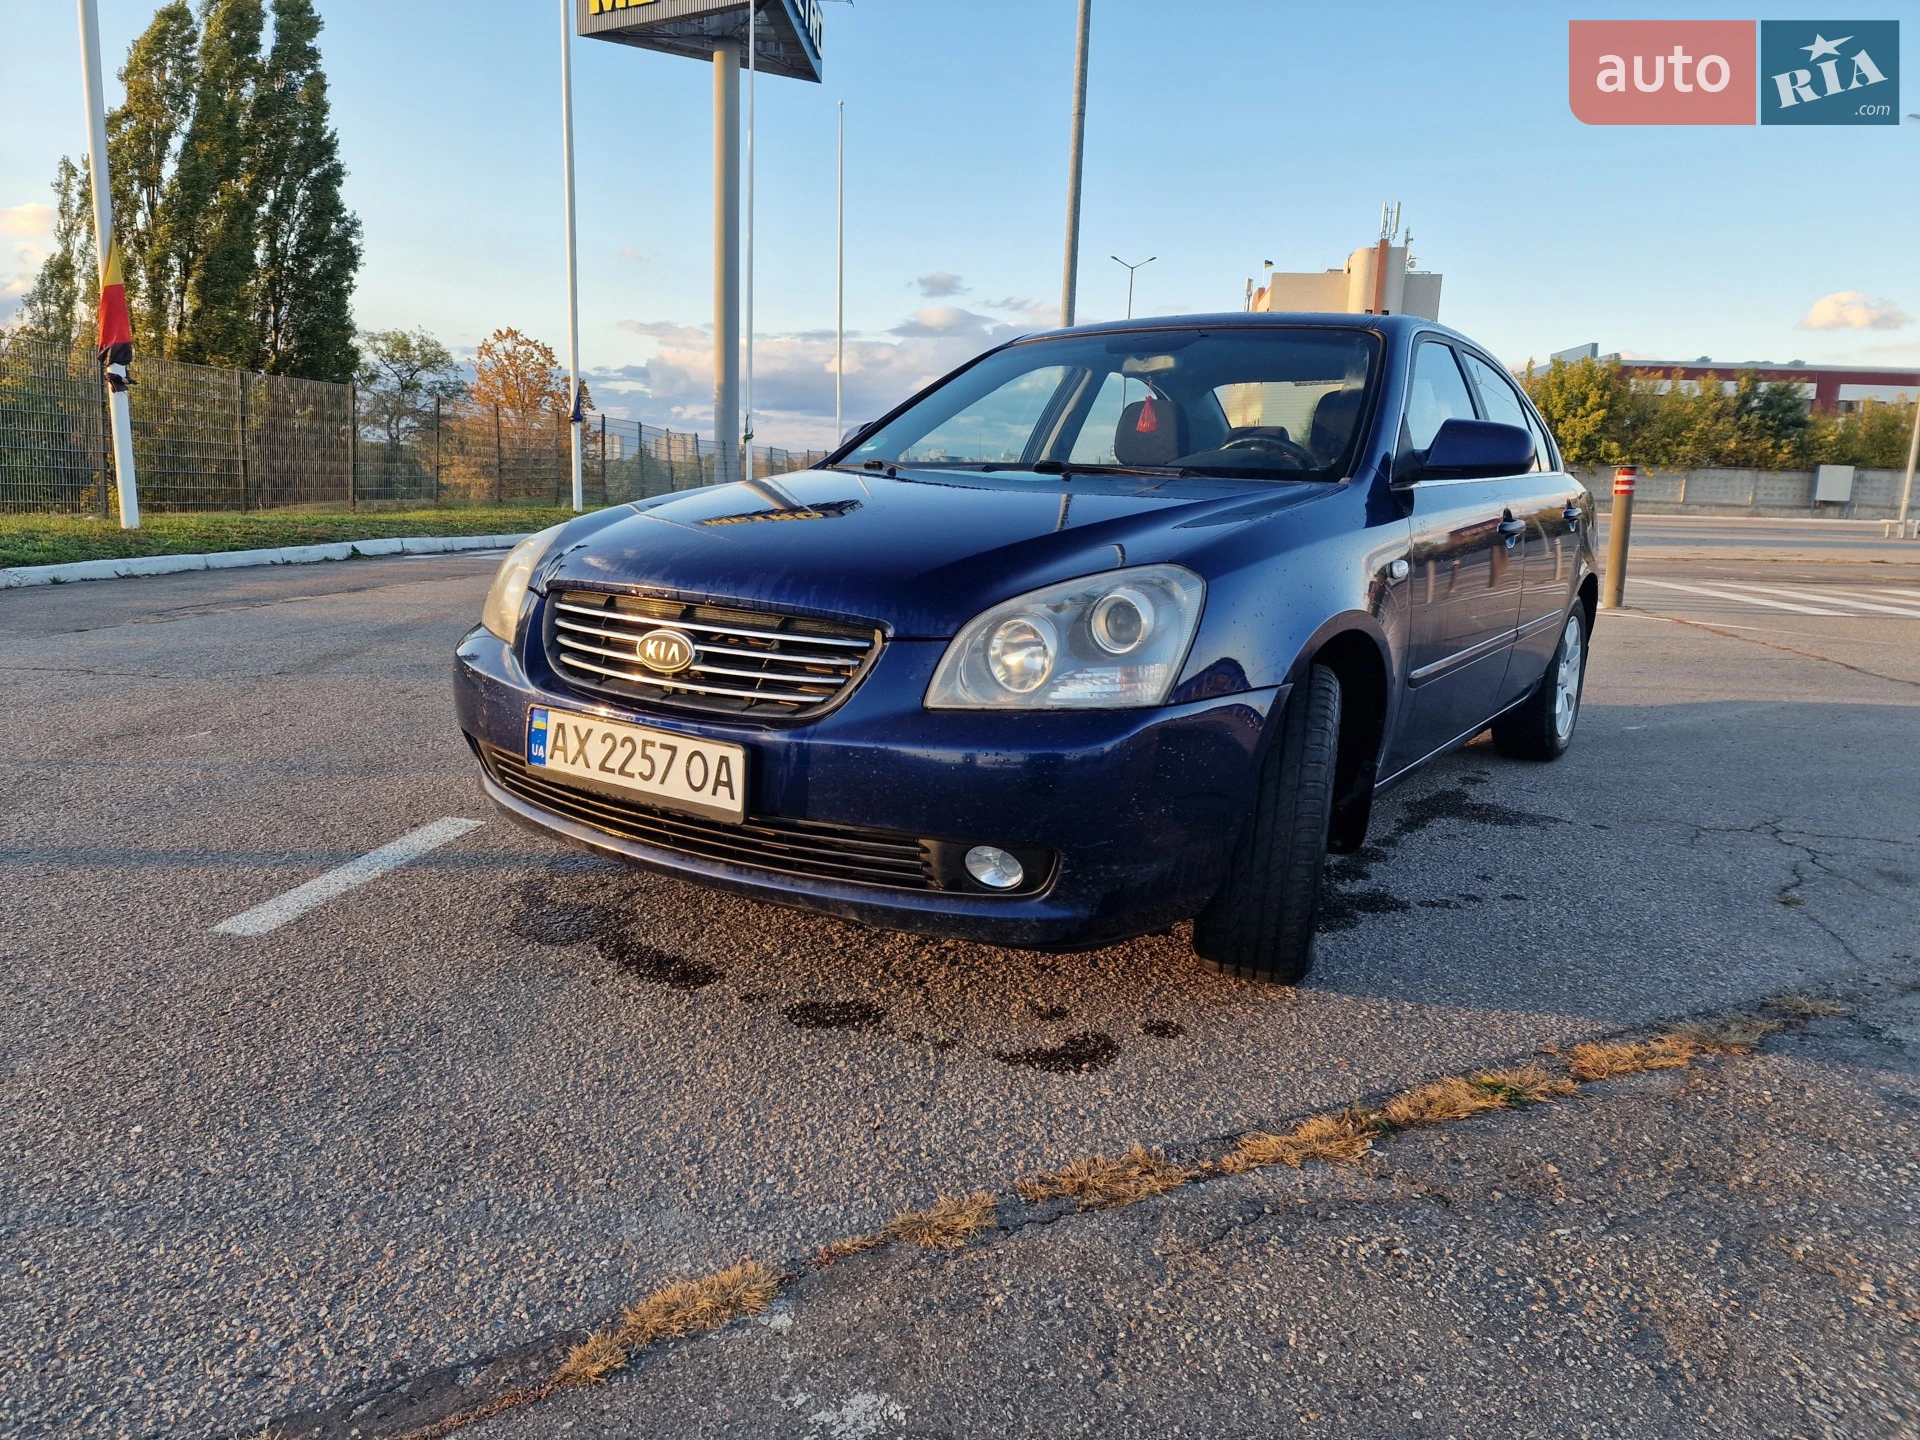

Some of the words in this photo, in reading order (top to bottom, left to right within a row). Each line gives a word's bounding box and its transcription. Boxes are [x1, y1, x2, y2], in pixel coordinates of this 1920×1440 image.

[645, 639, 680, 663] KIA
[531, 743, 545, 758] UA
[549, 722, 593, 769] AX
[598, 732, 678, 785] 2257
[685, 749, 735, 801] OA
